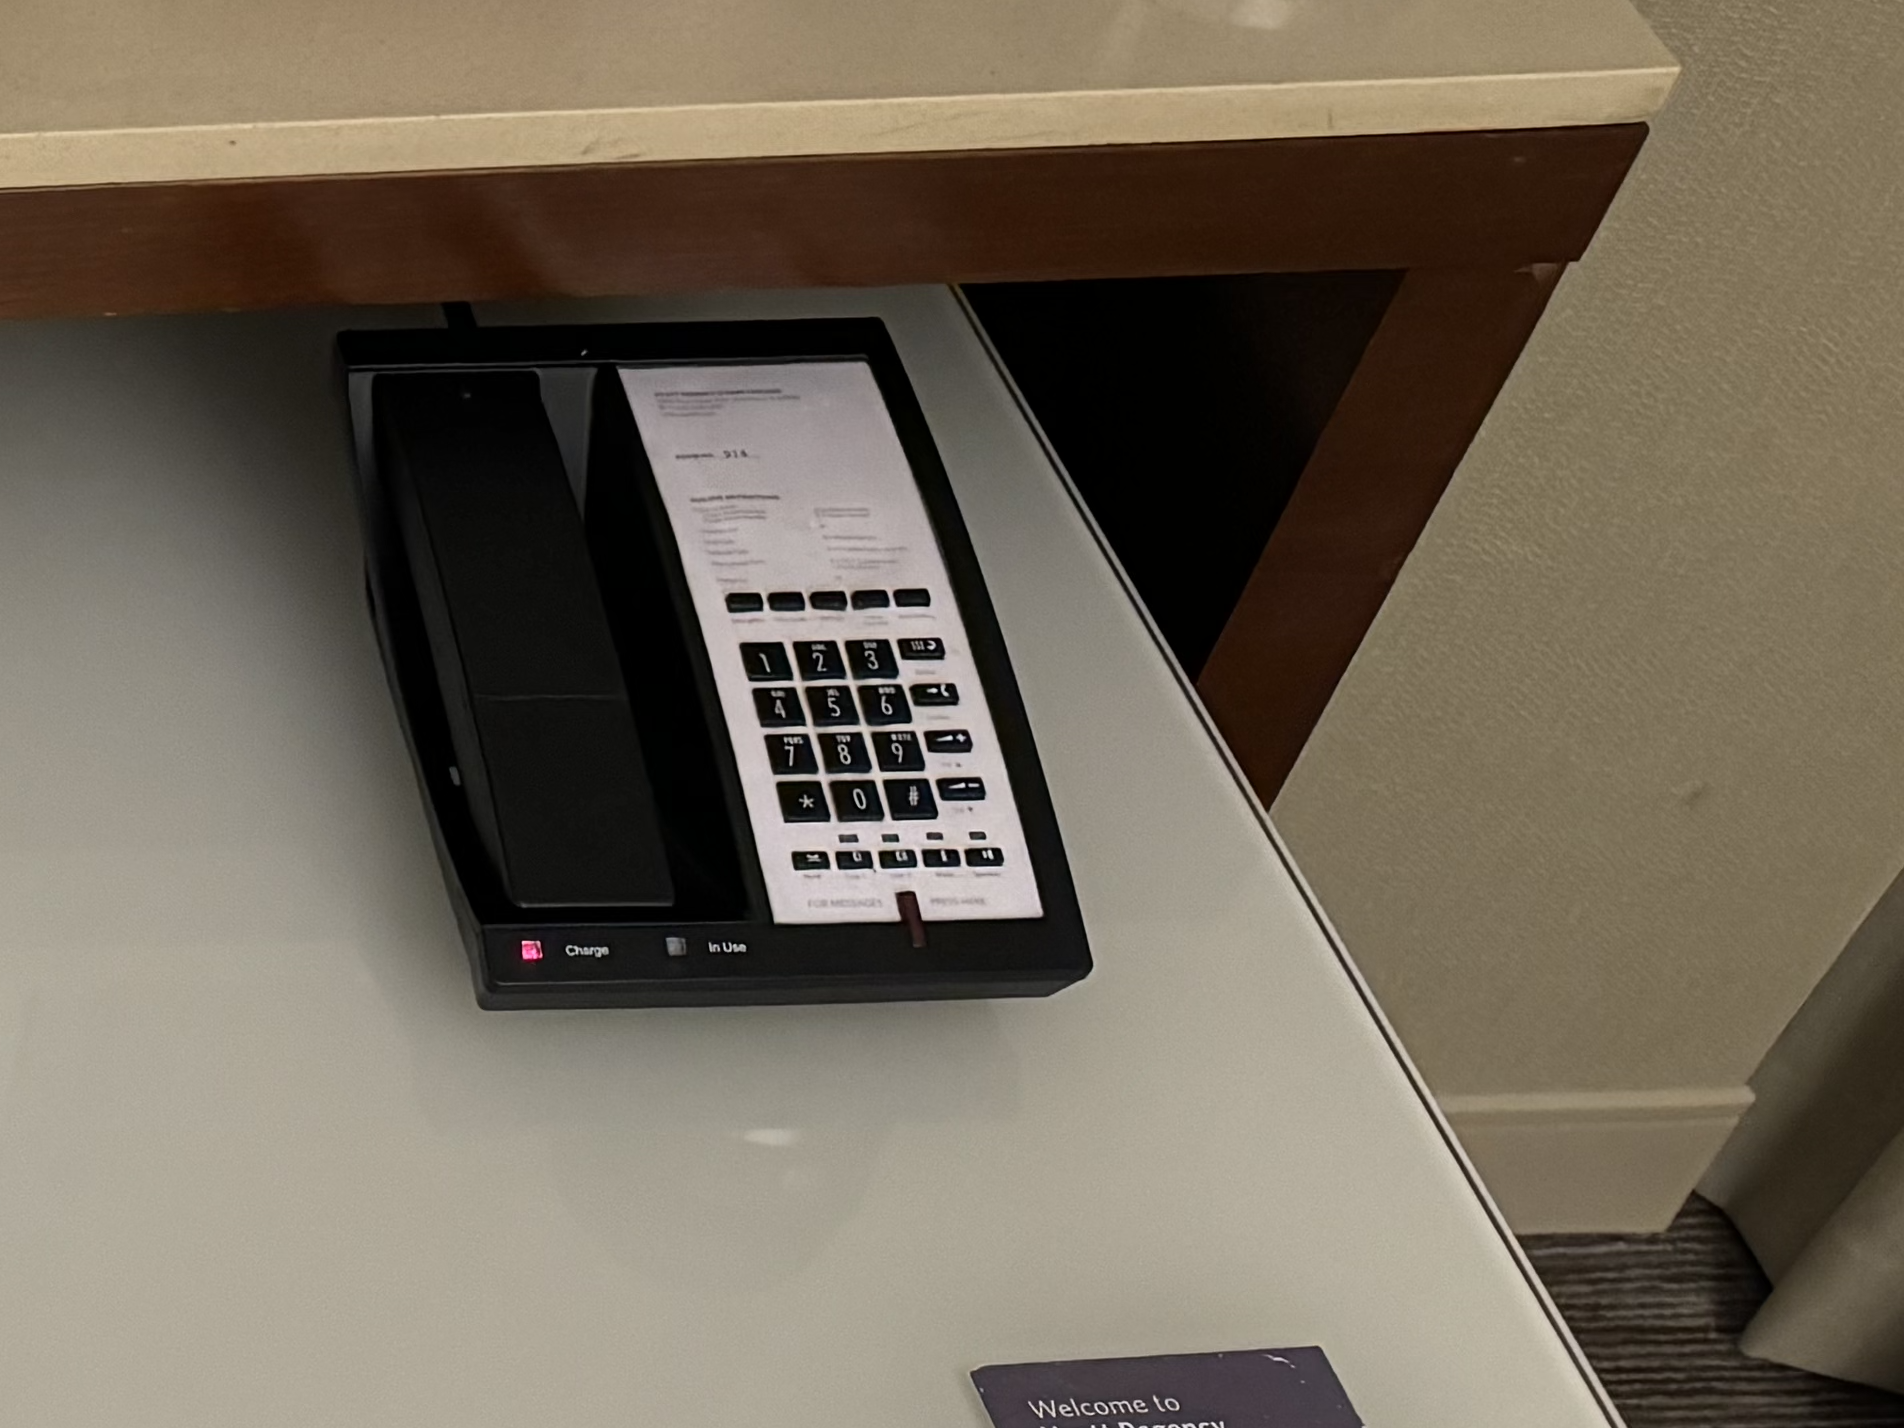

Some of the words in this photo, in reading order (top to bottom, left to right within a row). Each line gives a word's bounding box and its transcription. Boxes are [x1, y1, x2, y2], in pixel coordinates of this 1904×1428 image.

[758, 653, 771, 673] 1
[812, 652, 828, 672] 2
[865, 651, 880, 670] 3
[774, 698, 787, 719] 4
[827, 697, 841, 717] 5
[881, 695, 894, 715] 6
[784, 745, 795, 767] 7
[837, 743, 852, 765] 8
[891, 743, 904, 764] 9
[852, 788, 867, 810] 0
[565, 944, 610, 959] Charge
[708, 941, 721, 954] In
[723, 941, 748, 954] Use
[1027, 1397, 1149, 1419] Welcome
[1152, 1394, 1181, 1413] to
